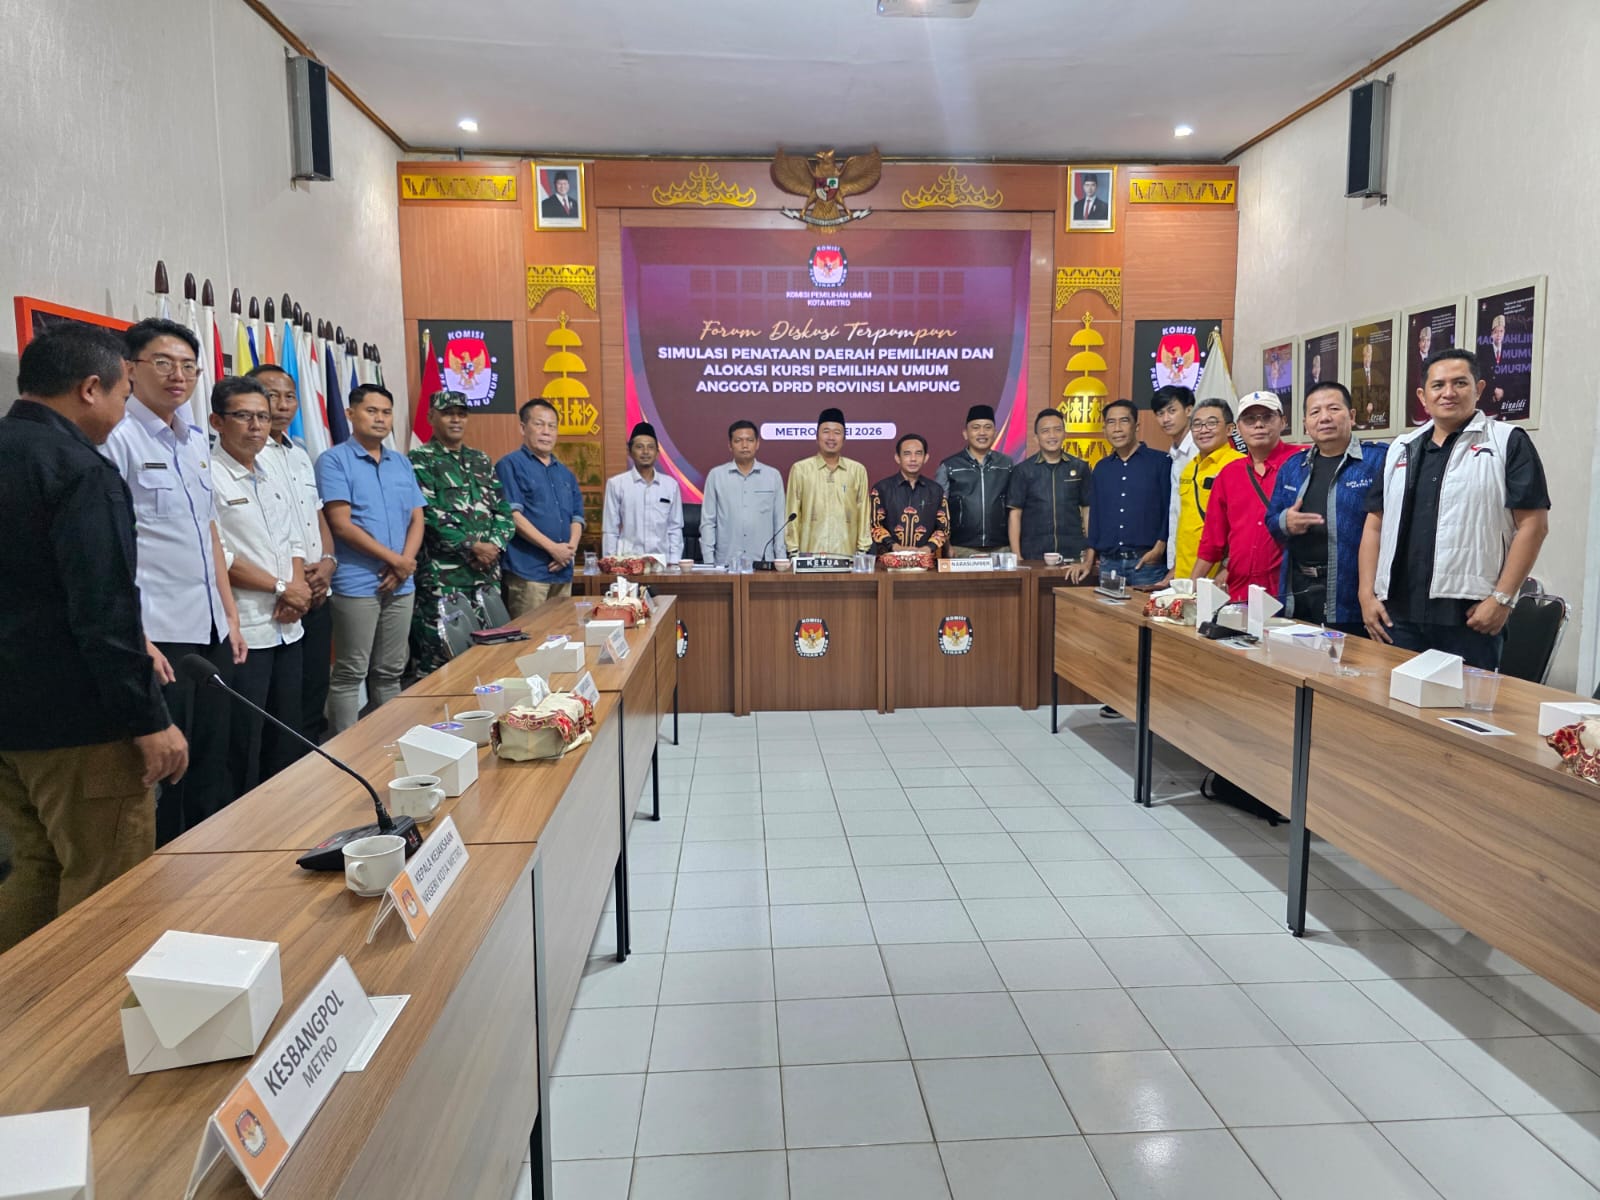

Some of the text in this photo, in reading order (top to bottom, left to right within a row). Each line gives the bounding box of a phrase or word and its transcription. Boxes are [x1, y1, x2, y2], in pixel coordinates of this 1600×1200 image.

[448, 330, 484, 340] KOMISI
[700, 318, 958, 346] Forum Diskusi Terpumpun
[1162, 326, 1196, 336] KOMISI
[658, 347, 994, 360] SIMULASI PENATAAN DAERAH PEMILIHAN DAN
[703, 364, 948, 376] ALOKASI KURSI PEMILIHAN UMUM
[482, 373, 498, 406] UMUM
[696, 380, 960, 392] ANGGOTA DPRD PROVINSI LAMPUNG
[855, 427, 882, 436] 2026
[414, 858, 432, 884] KEPALA
[264, 990, 344, 1096] KESBANGPOL
[302, 1036, 338, 1088] METRO
